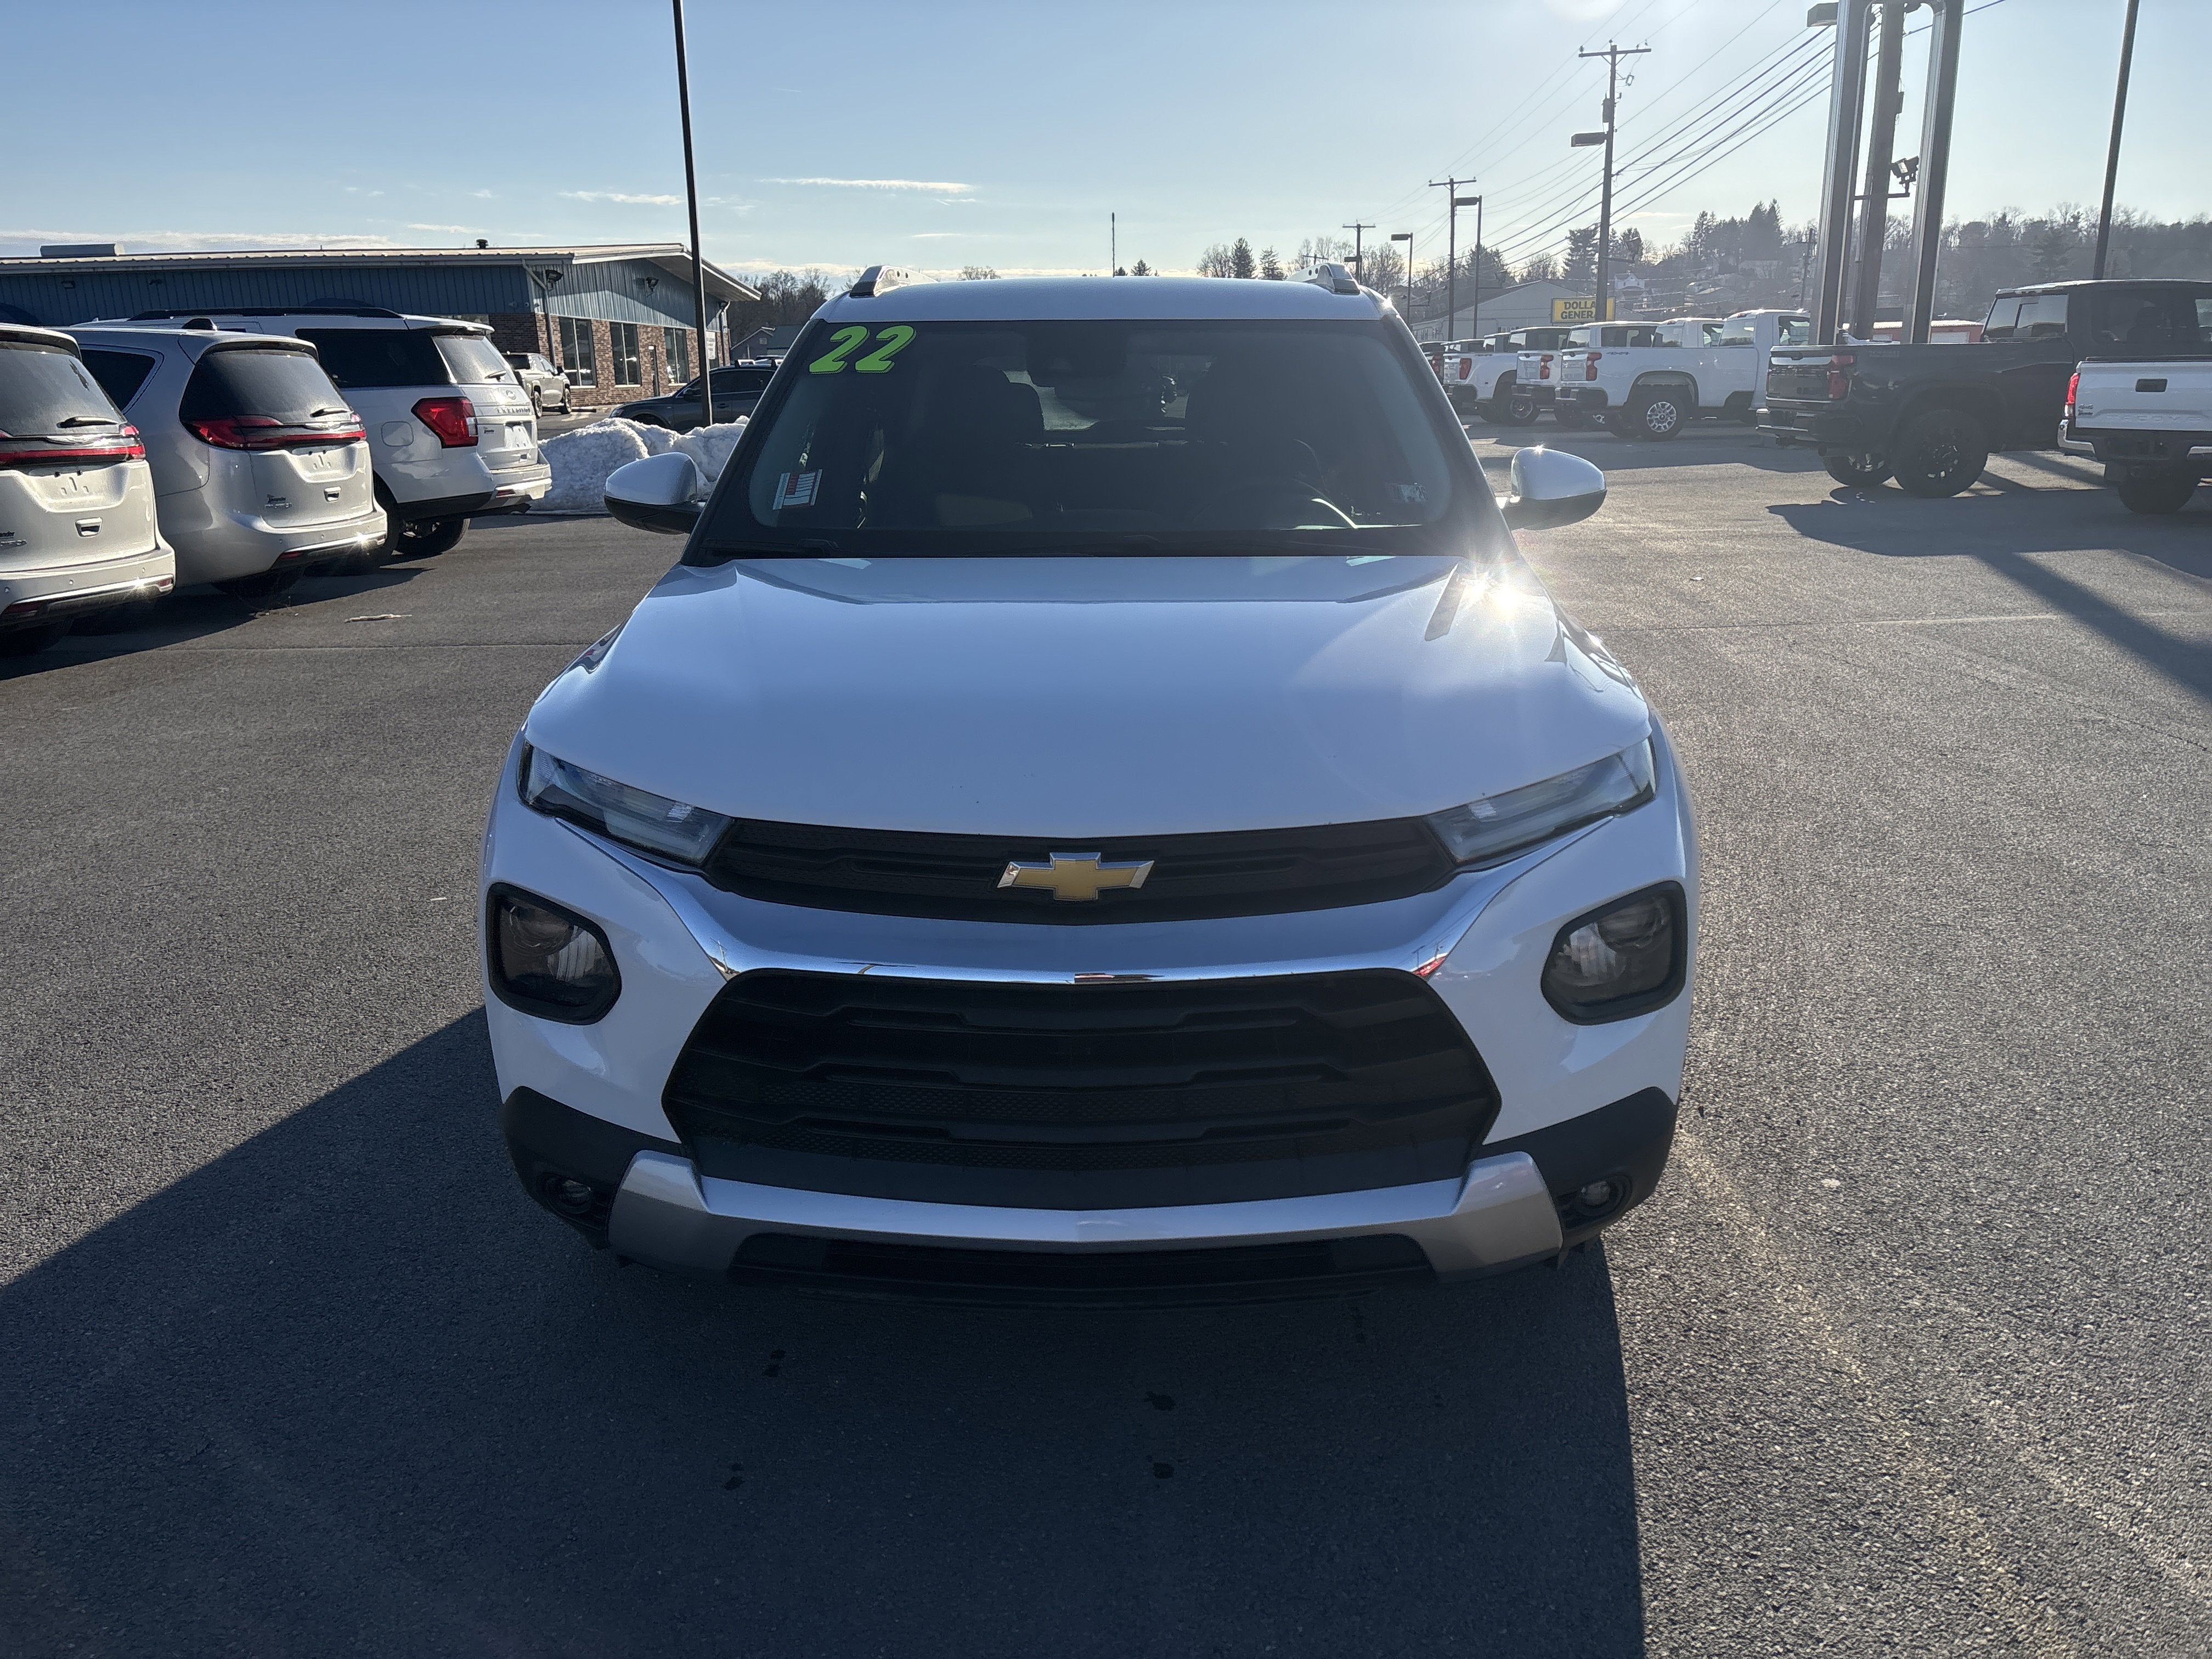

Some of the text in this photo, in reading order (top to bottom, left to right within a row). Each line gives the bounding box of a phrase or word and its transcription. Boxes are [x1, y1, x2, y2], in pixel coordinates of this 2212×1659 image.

[1564, 301, 1596, 310] DOLLA
[1560, 310, 1596, 319] GENER
[809, 325, 917, 375] 22
